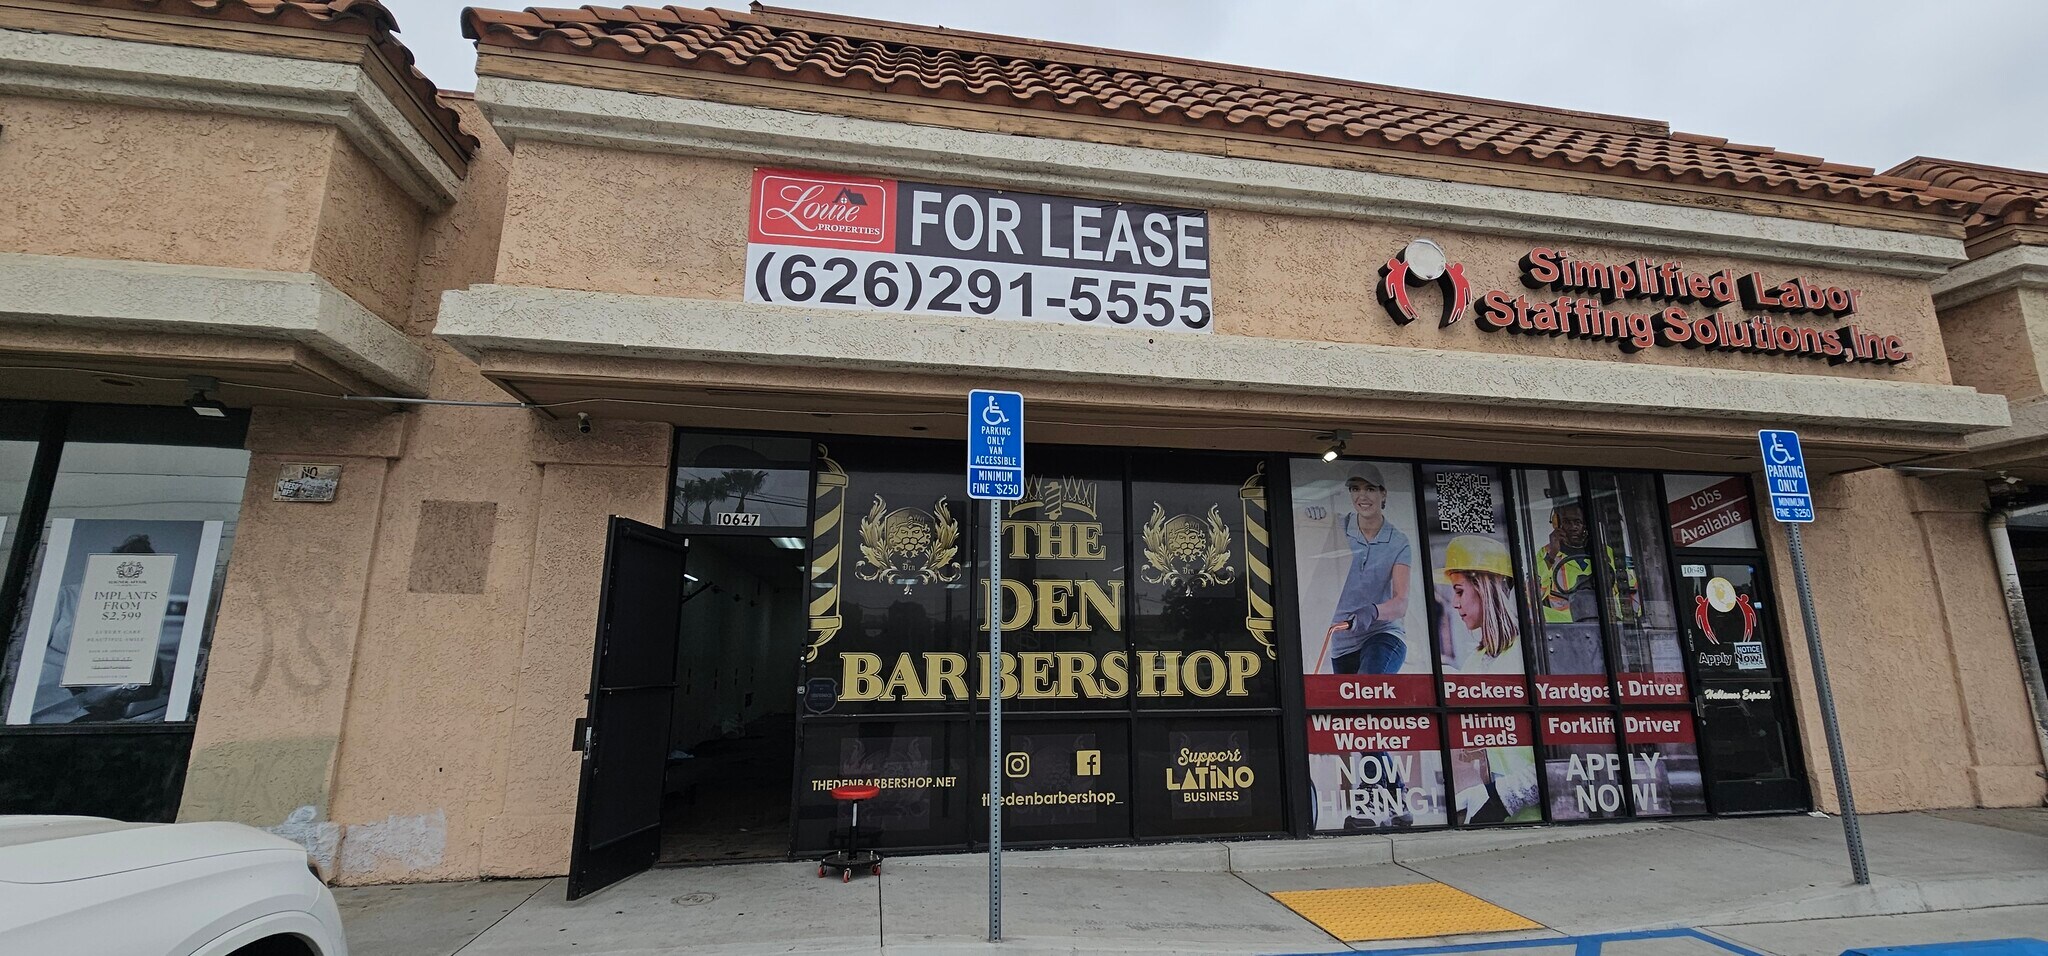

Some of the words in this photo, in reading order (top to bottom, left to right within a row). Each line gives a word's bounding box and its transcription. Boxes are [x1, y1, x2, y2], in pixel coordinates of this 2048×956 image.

[817, 223, 880, 235] PROPERTIES
[912, 190, 1023, 254] FOR
[1041, 203, 1207, 270] LEASE
[1528, 247, 1738, 303] Simplified
[1751, 271, 1862, 313] Labor
[755, 251, 1211, 330] (626)291-5555
[1485, 289, 1655, 348] Staffing
[981, 425, 1011, 436] PARKING
[987, 436, 1006, 445] ONLY
[989, 446, 1003, 455] VAN
[975, 456, 1017, 466] ACCESSIBLE
[301, 466, 318, 479] NO
[978, 470, 1013, 482] MINIMUM
[1767, 464, 1804, 478] PARKING
[972, 482, 990, 494] FINE
[1777, 478, 1798, 492] ONLY
[1690, 489, 1722, 511] Jobs
[1778, 497, 1806, 507] MINIMUM
[717, 513, 759, 526] 10647
[1775, 507, 1791, 518] FINE
[1680, 510, 1742, 544] Available
[1000, 520, 1108, 561] THE
[94, 591, 158, 600] IMPLANTS
[103, 601, 141, 610] FROM
[979, 578, 1124, 633] DEN
[1736, 645, 1760, 653] NOTICE
[1699, 652, 1733, 666] Apply
[1339, 682, 1396, 699] Clerk
[1443, 682, 1525, 699] Packers
[1628, 680, 1684, 697] Driver
[1311, 713, 1430, 731] Warehouse
[1460, 713, 1516, 731] Hiring
[1624, 716, 1681, 733] Driver
[1334, 732, 1411, 750] Worker
[1462, 730, 1518, 747] Leads
[1177, 747, 1242, 767] Support
[1335, 755, 1413, 785] NOW
[1565, 752, 1661, 782] APPLY
[811, 776, 957, 791] THEDENBARBERSHOP.NET
[1183, 791, 1239, 803] BUSINESS
[1317, 786, 1439, 818] HIRING!
